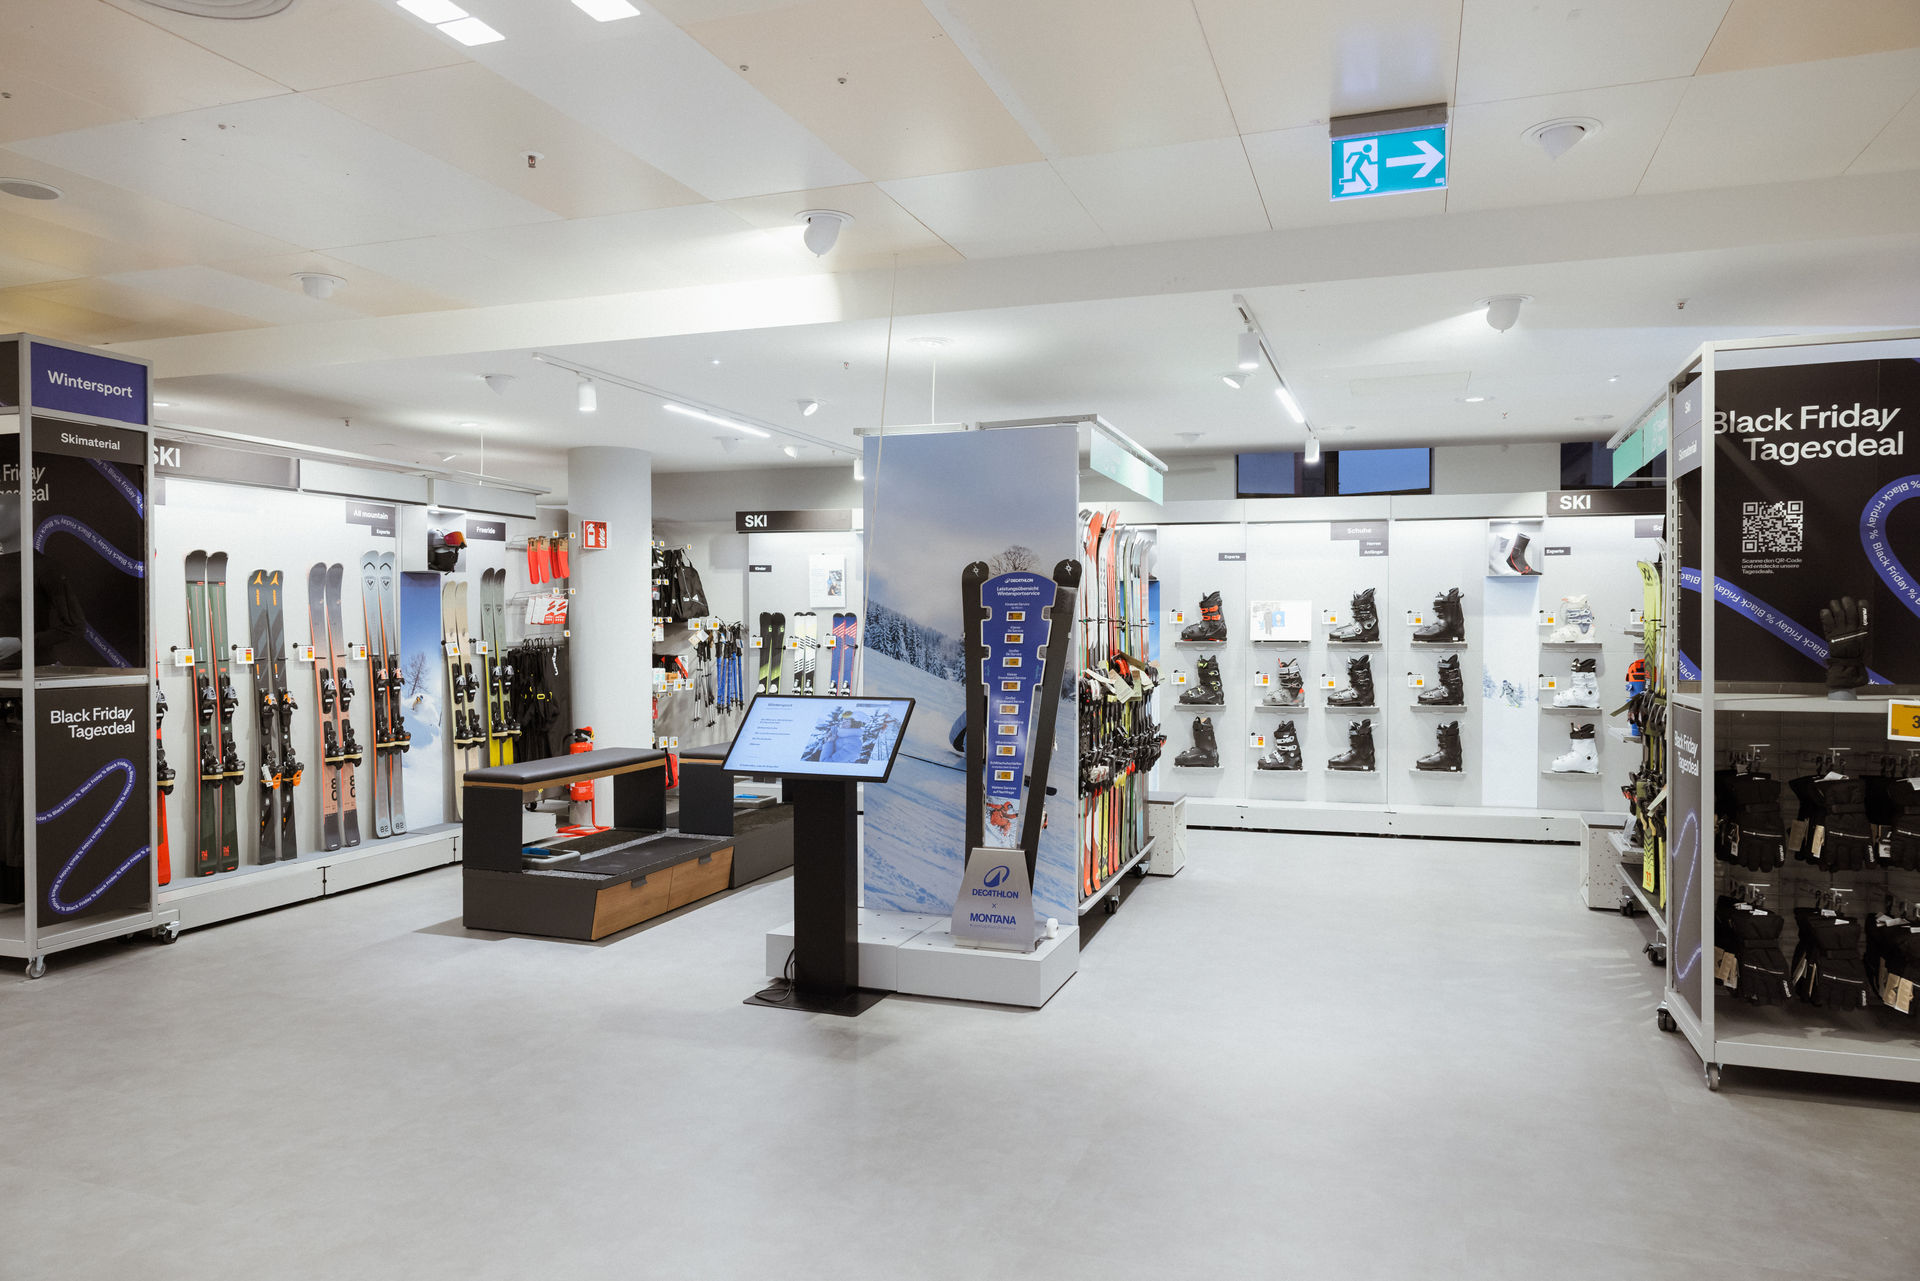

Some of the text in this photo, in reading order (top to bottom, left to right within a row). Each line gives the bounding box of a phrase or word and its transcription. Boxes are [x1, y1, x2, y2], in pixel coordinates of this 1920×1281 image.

[48, 370, 133, 398] Wintersport
[1714, 403, 1901, 435] Black Friday
[61, 432, 120, 451] Skimaterial
[1742, 431, 1904, 466] Tagesdeal
[121, 481, 136, 498] Friday
[1882, 482, 1909, 502] Black
[1560, 495, 1591, 510] SKI
[744, 514, 768, 528] SKI
[1866, 500, 1886, 528] Friday
[1869, 529, 1879, 540] %
[1872, 542, 1890, 567] Black
[1886, 565, 1909, 591] Friday
[1907, 588, 1918, 599] %
[1680, 573, 1828, 658] Black Friday % Black Friday Blac
[50, 707, 134, 725] Black Friday
[68, 720, 135, 740] Tagesdeal
[972, 888, 1019, 899] DECATHLON
[970, 912, 1016, 925] MONTANA
